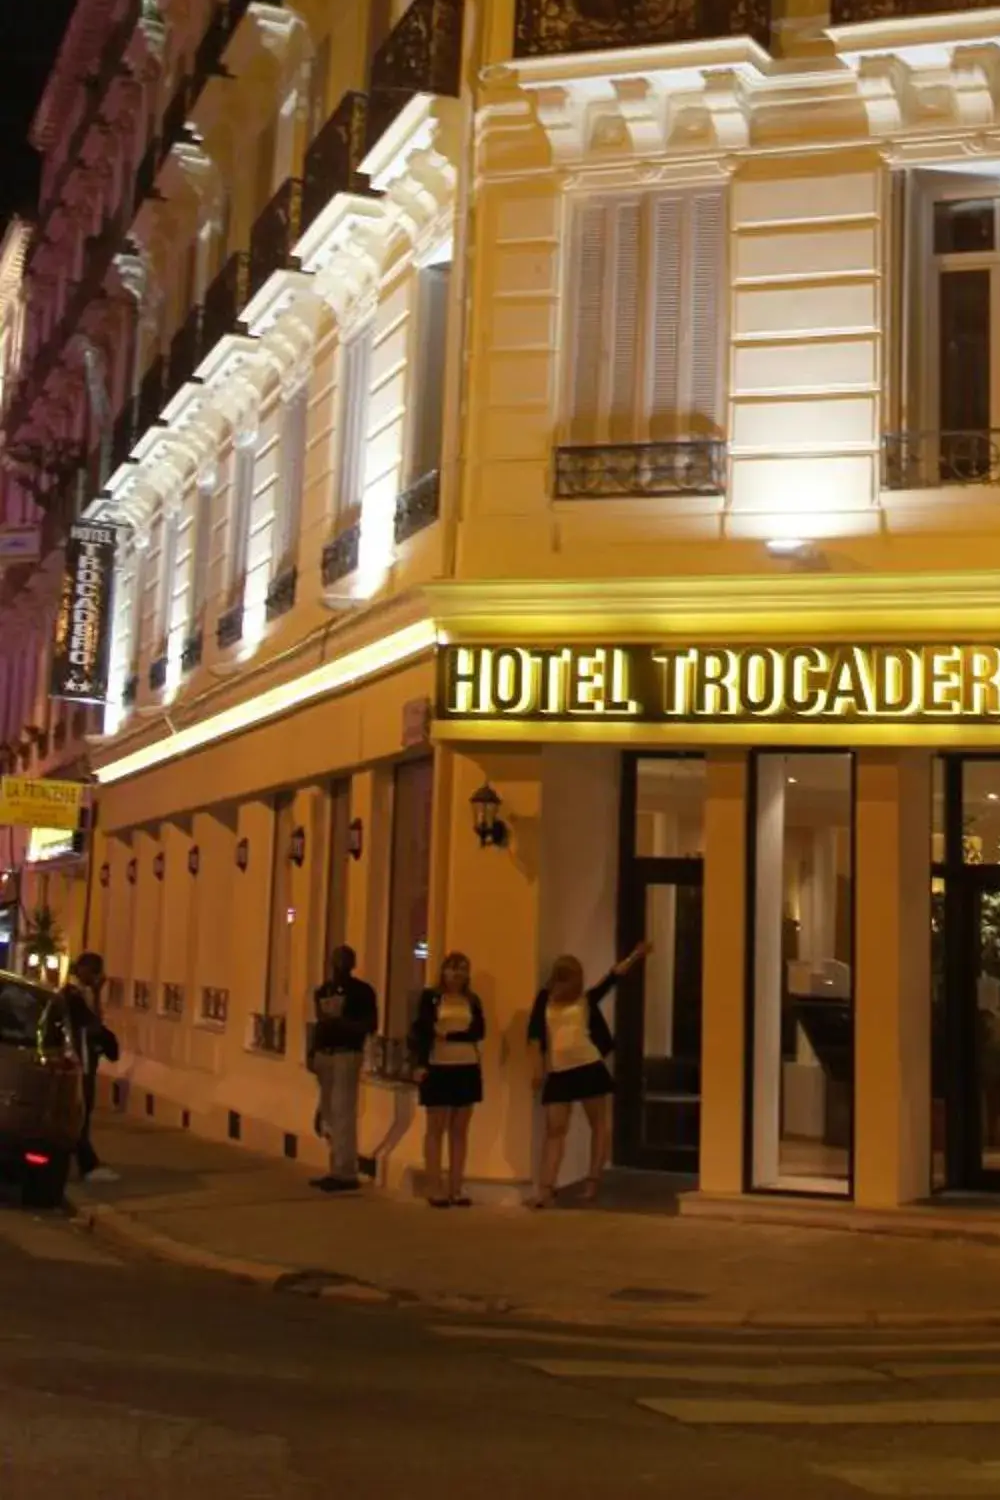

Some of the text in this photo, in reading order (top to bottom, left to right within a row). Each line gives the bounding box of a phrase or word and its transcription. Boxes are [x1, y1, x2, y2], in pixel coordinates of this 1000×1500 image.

[70, 526, 112, 543] HOTEL
[69, 542, 102, 664] TROCADERO
[449, 645, 638, 716] HOTEL
